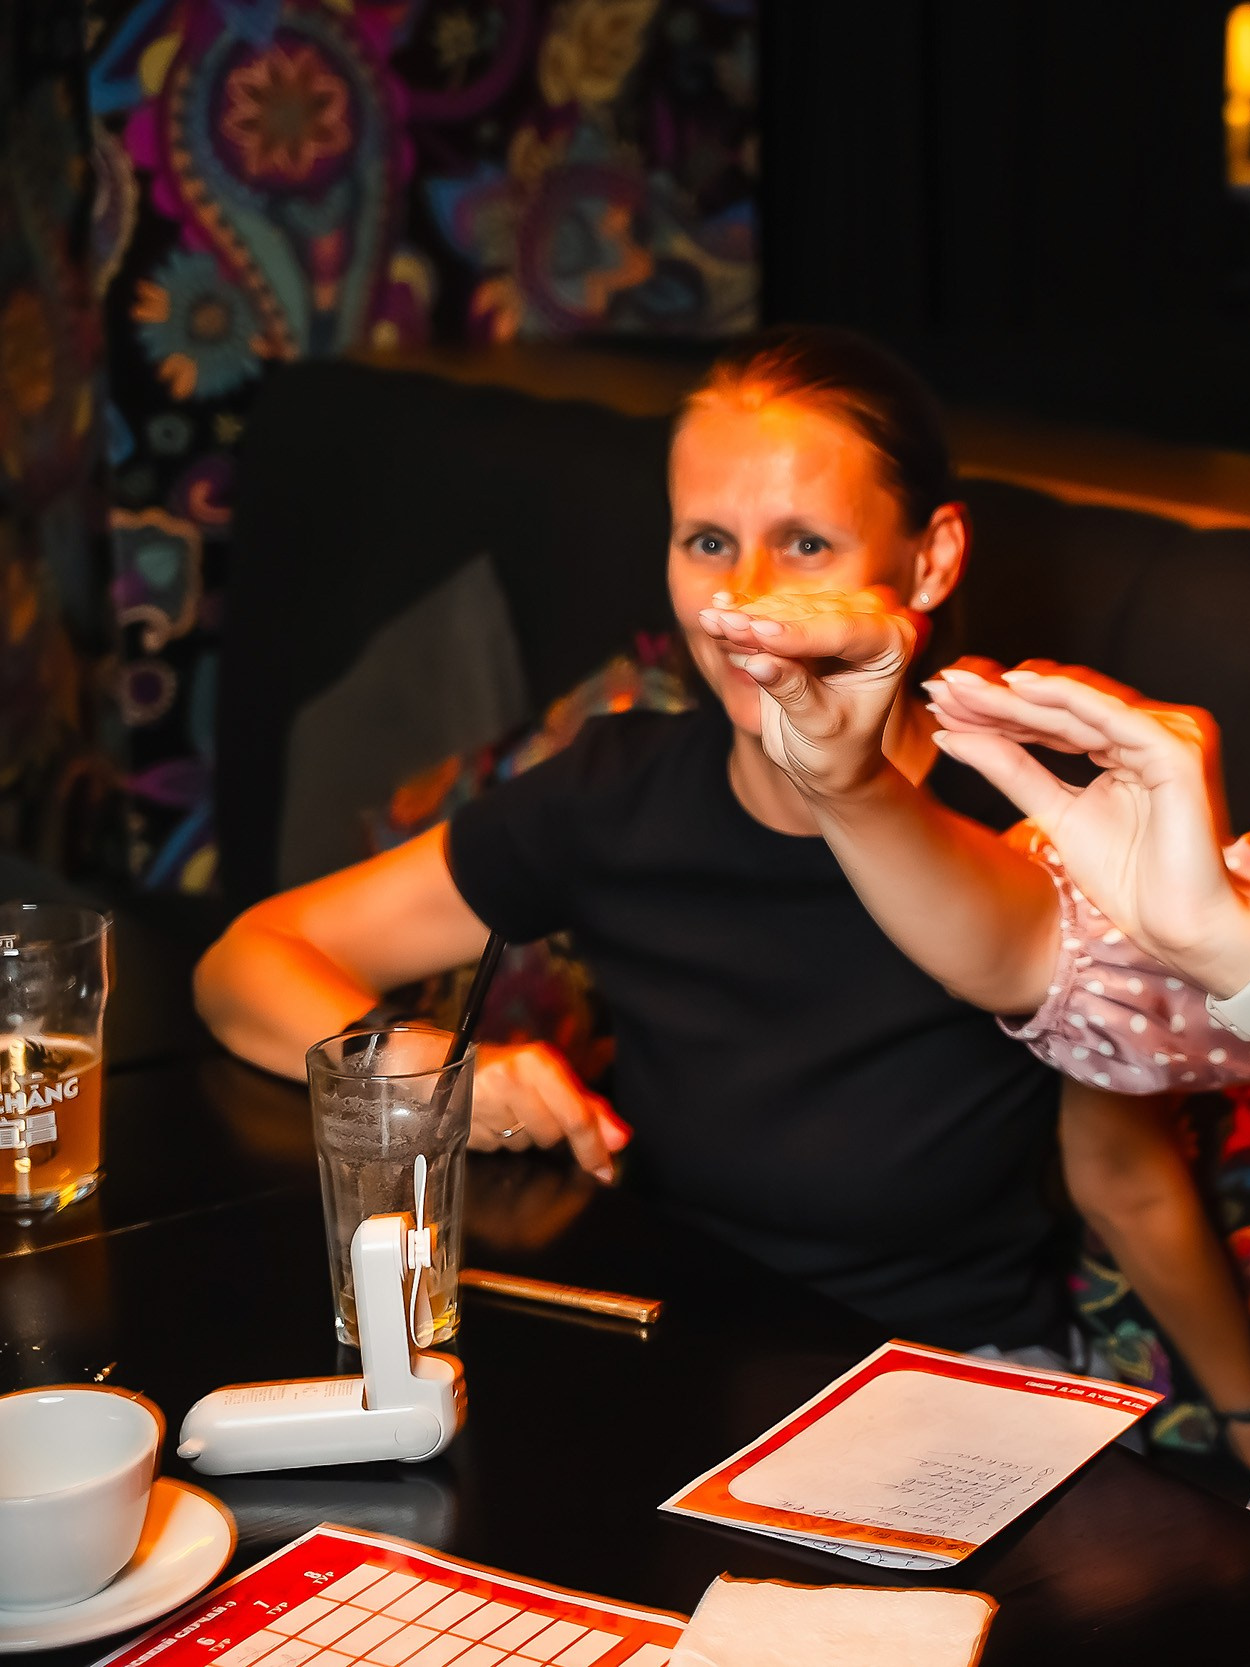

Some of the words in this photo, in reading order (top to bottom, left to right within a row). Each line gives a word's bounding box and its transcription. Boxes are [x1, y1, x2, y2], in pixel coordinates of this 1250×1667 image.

[303, 1570, 322, 1580] 8
[312, 1571, 335, 1585] ТУР
[265, 1600, 288, 1616] ТУР
[196, 1637, 216, 1647] 6
[207, 1637, 231, 1653] ТУР
